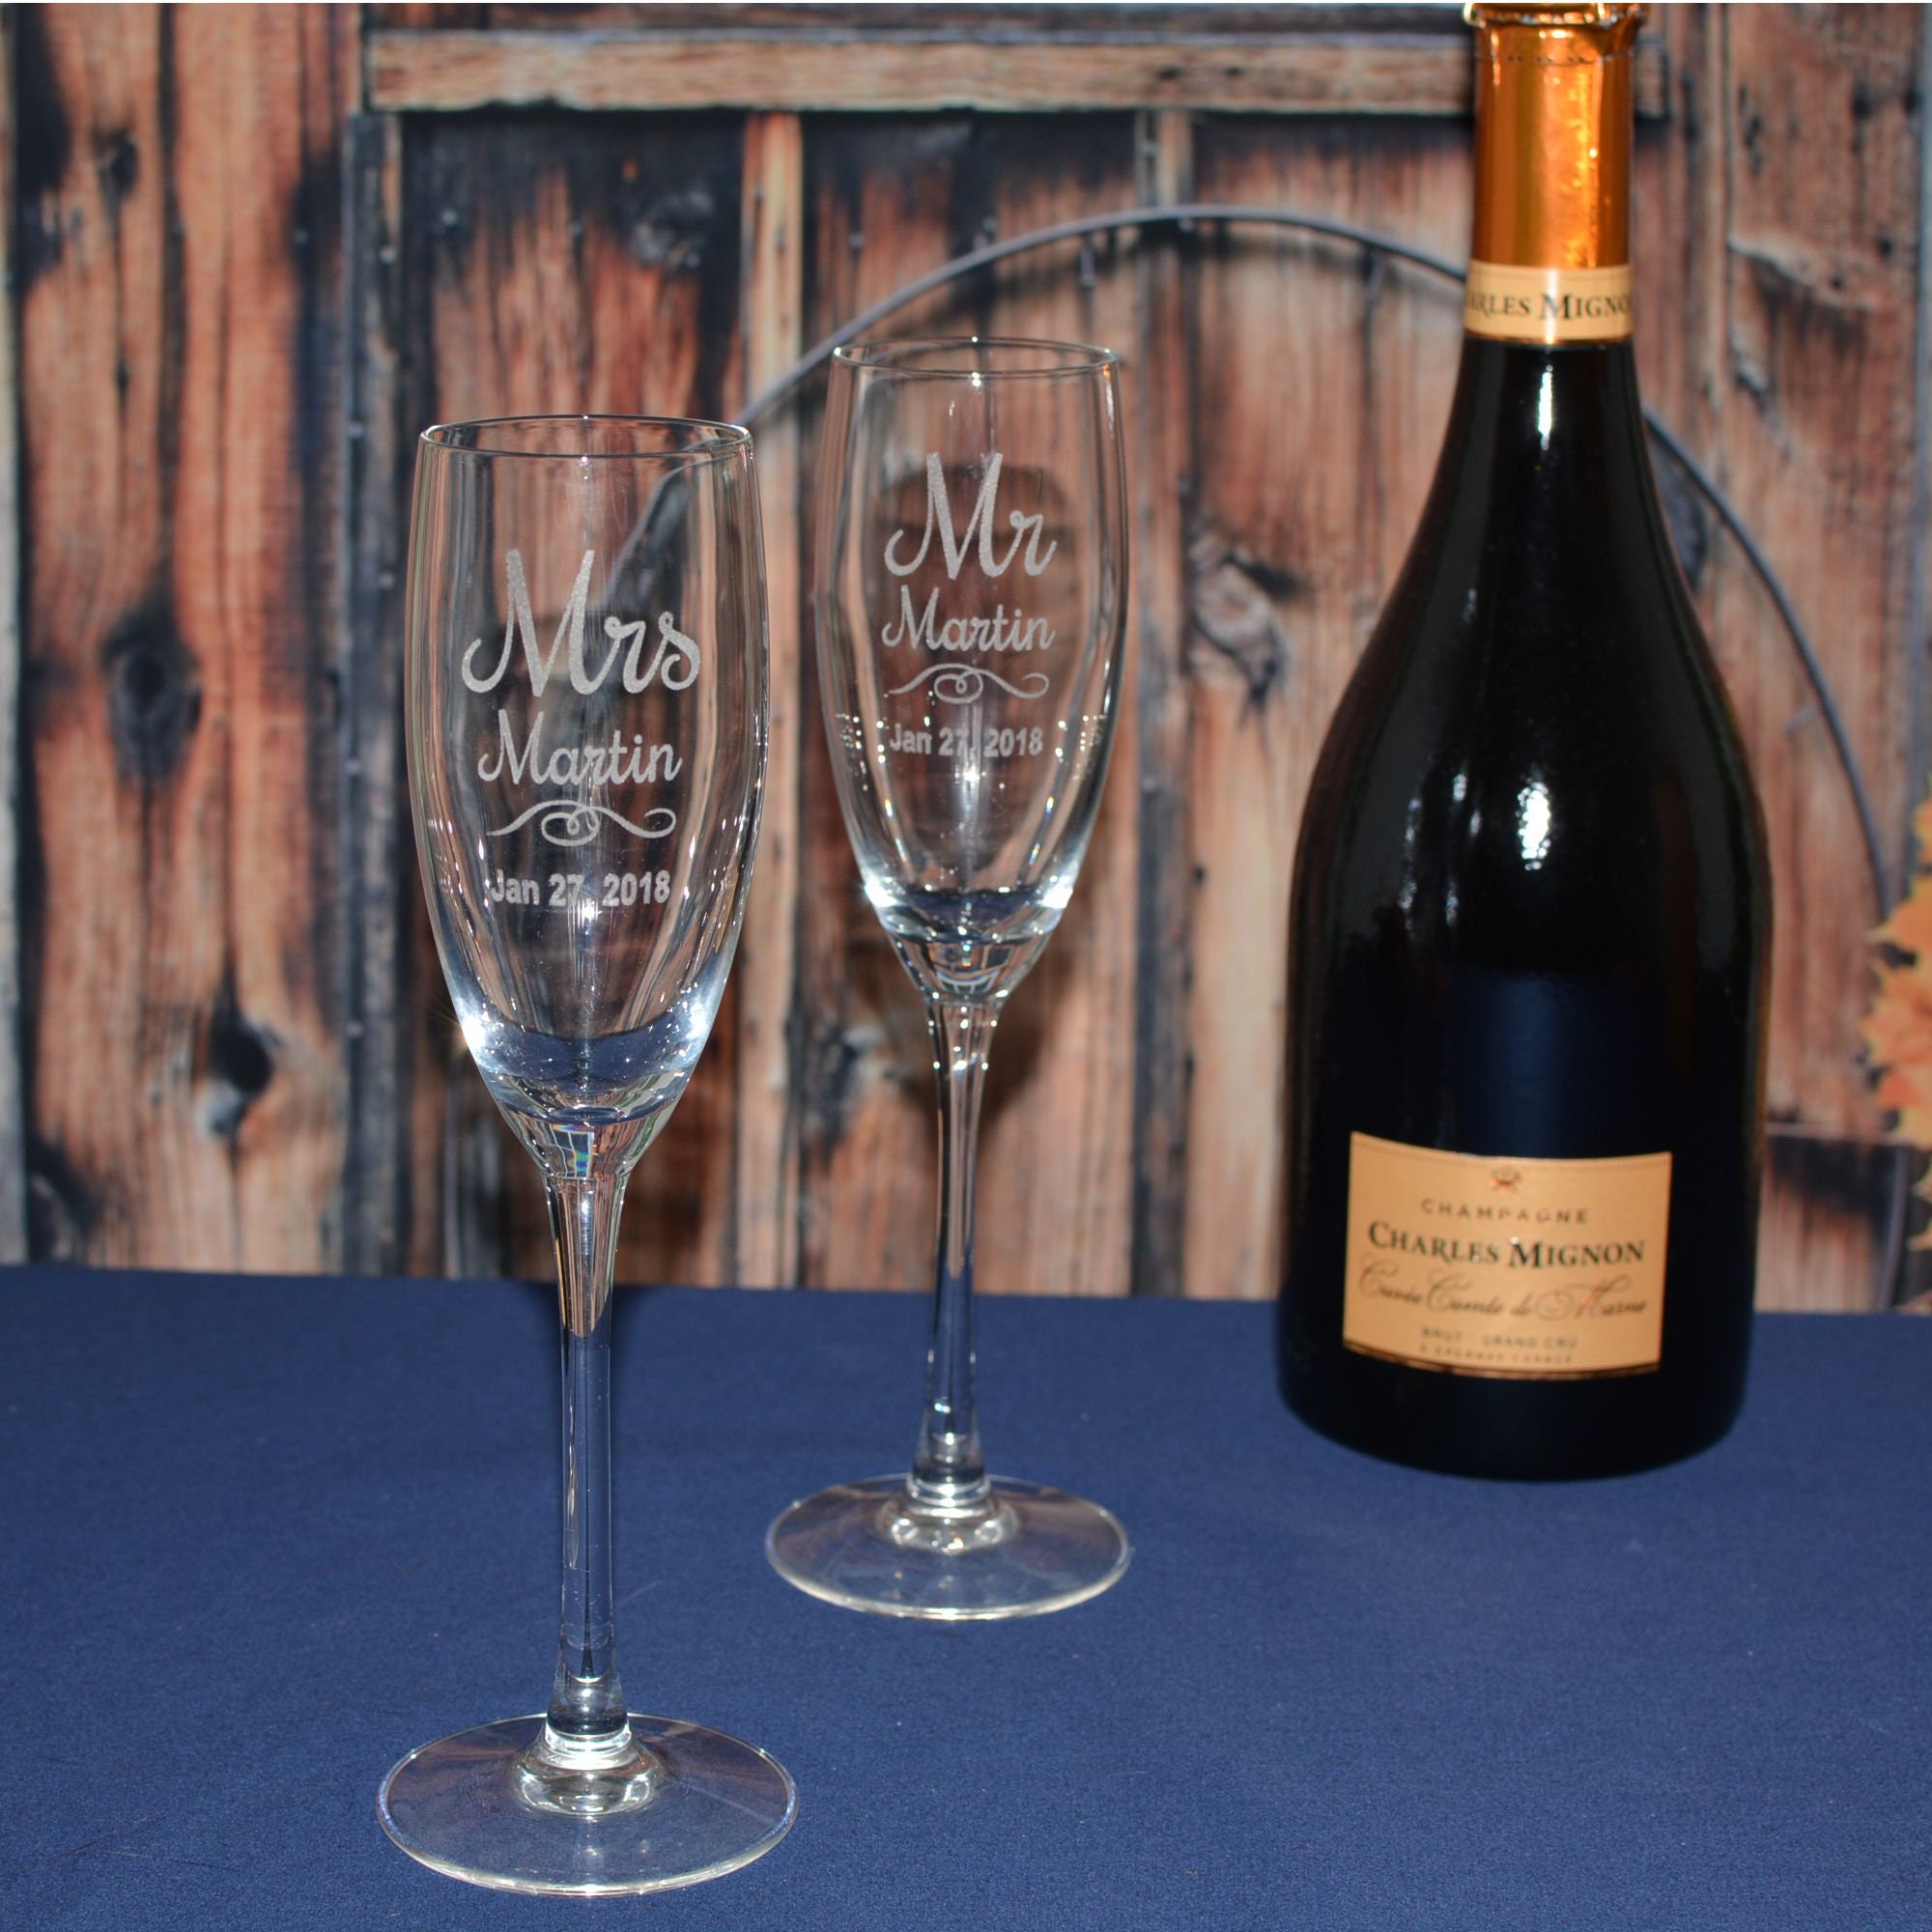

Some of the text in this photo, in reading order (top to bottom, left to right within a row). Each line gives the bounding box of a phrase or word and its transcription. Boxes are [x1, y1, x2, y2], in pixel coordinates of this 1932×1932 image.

[884, 452, 1057, 580] Mr
[462, 549, 700, 696] Mrs
[882, 584, 1056, 651] Martin
[477, 709, 683, 785] Martin
[889, 724, 933, 754] Jan
[983, 726, 1043, 757] 2018
[490, 868, 540, 906] Jan
[602, 869, 670, 908] 2018
[1421, 1198, 1588, 1224] CHAMPAGNE
[1369, 1220, 1646, 1268] CHARLES MIGNON
